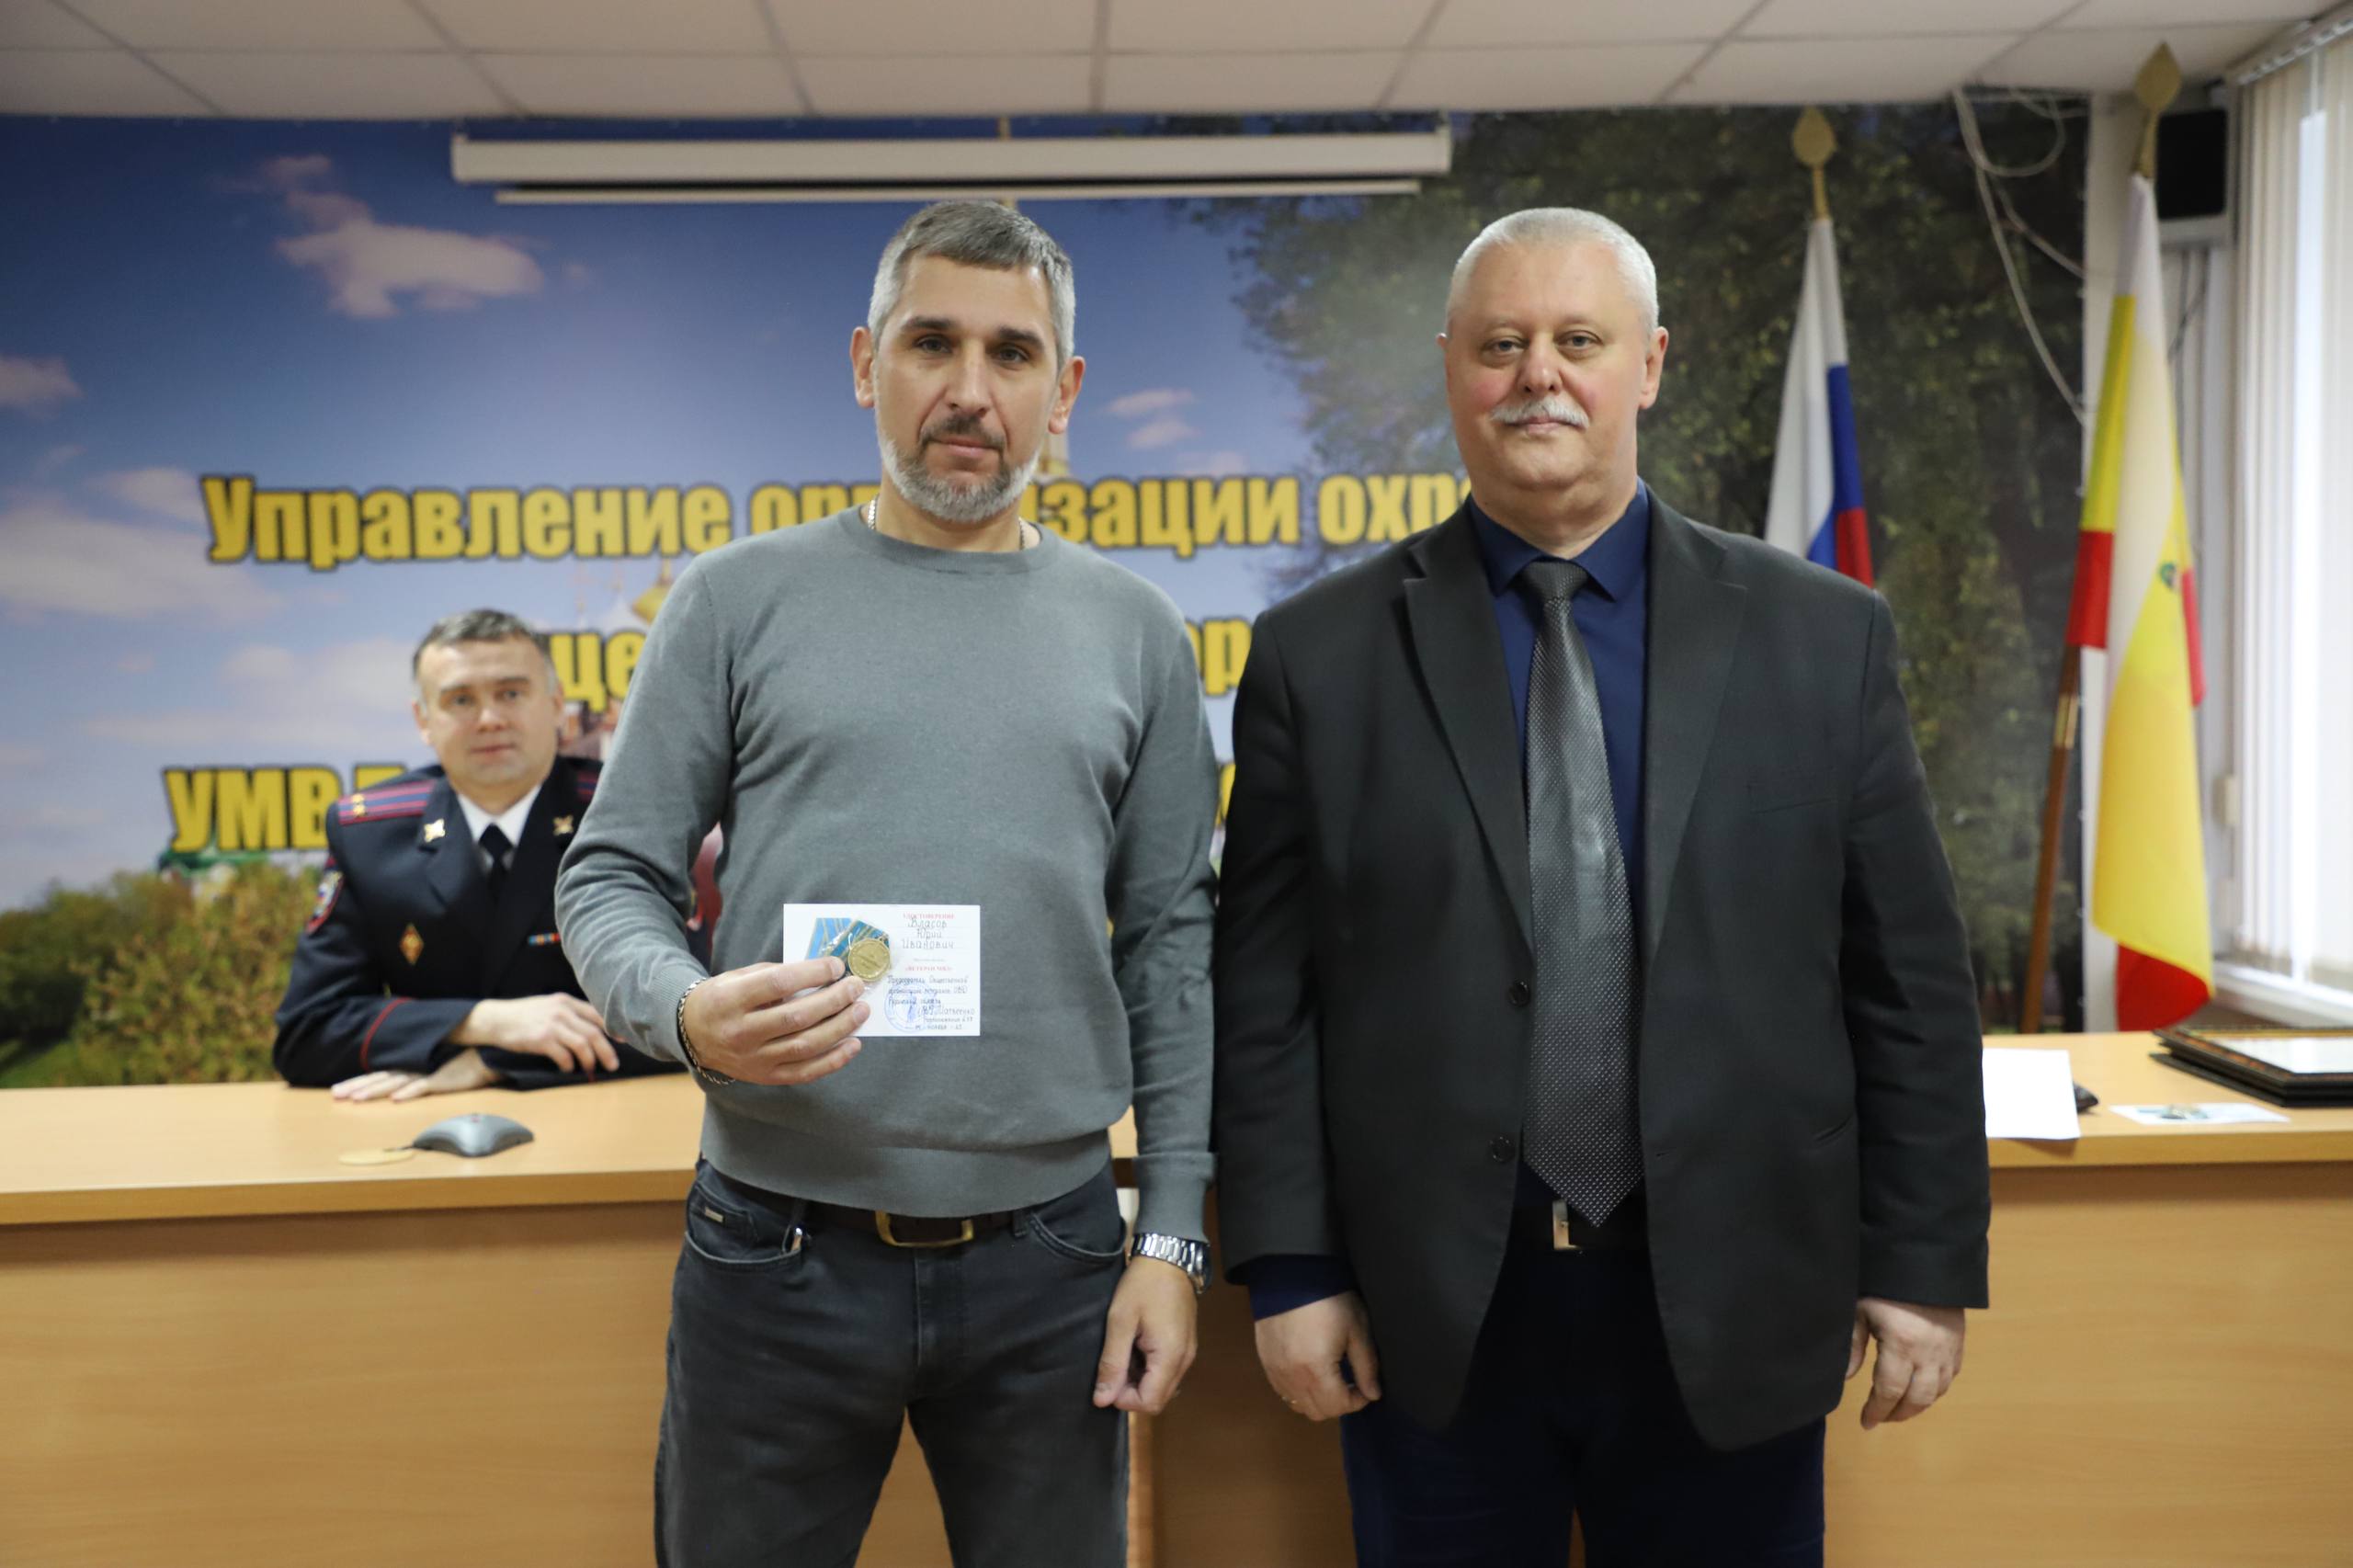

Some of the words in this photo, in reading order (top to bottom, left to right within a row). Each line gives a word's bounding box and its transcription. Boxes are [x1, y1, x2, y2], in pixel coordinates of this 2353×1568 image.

[199, 473, 733, 572] Управление
[162, 765, 406, 852] УМВ
[902, 937, 954, 949] Иванович
[907, 917, 948, 929] Власов
